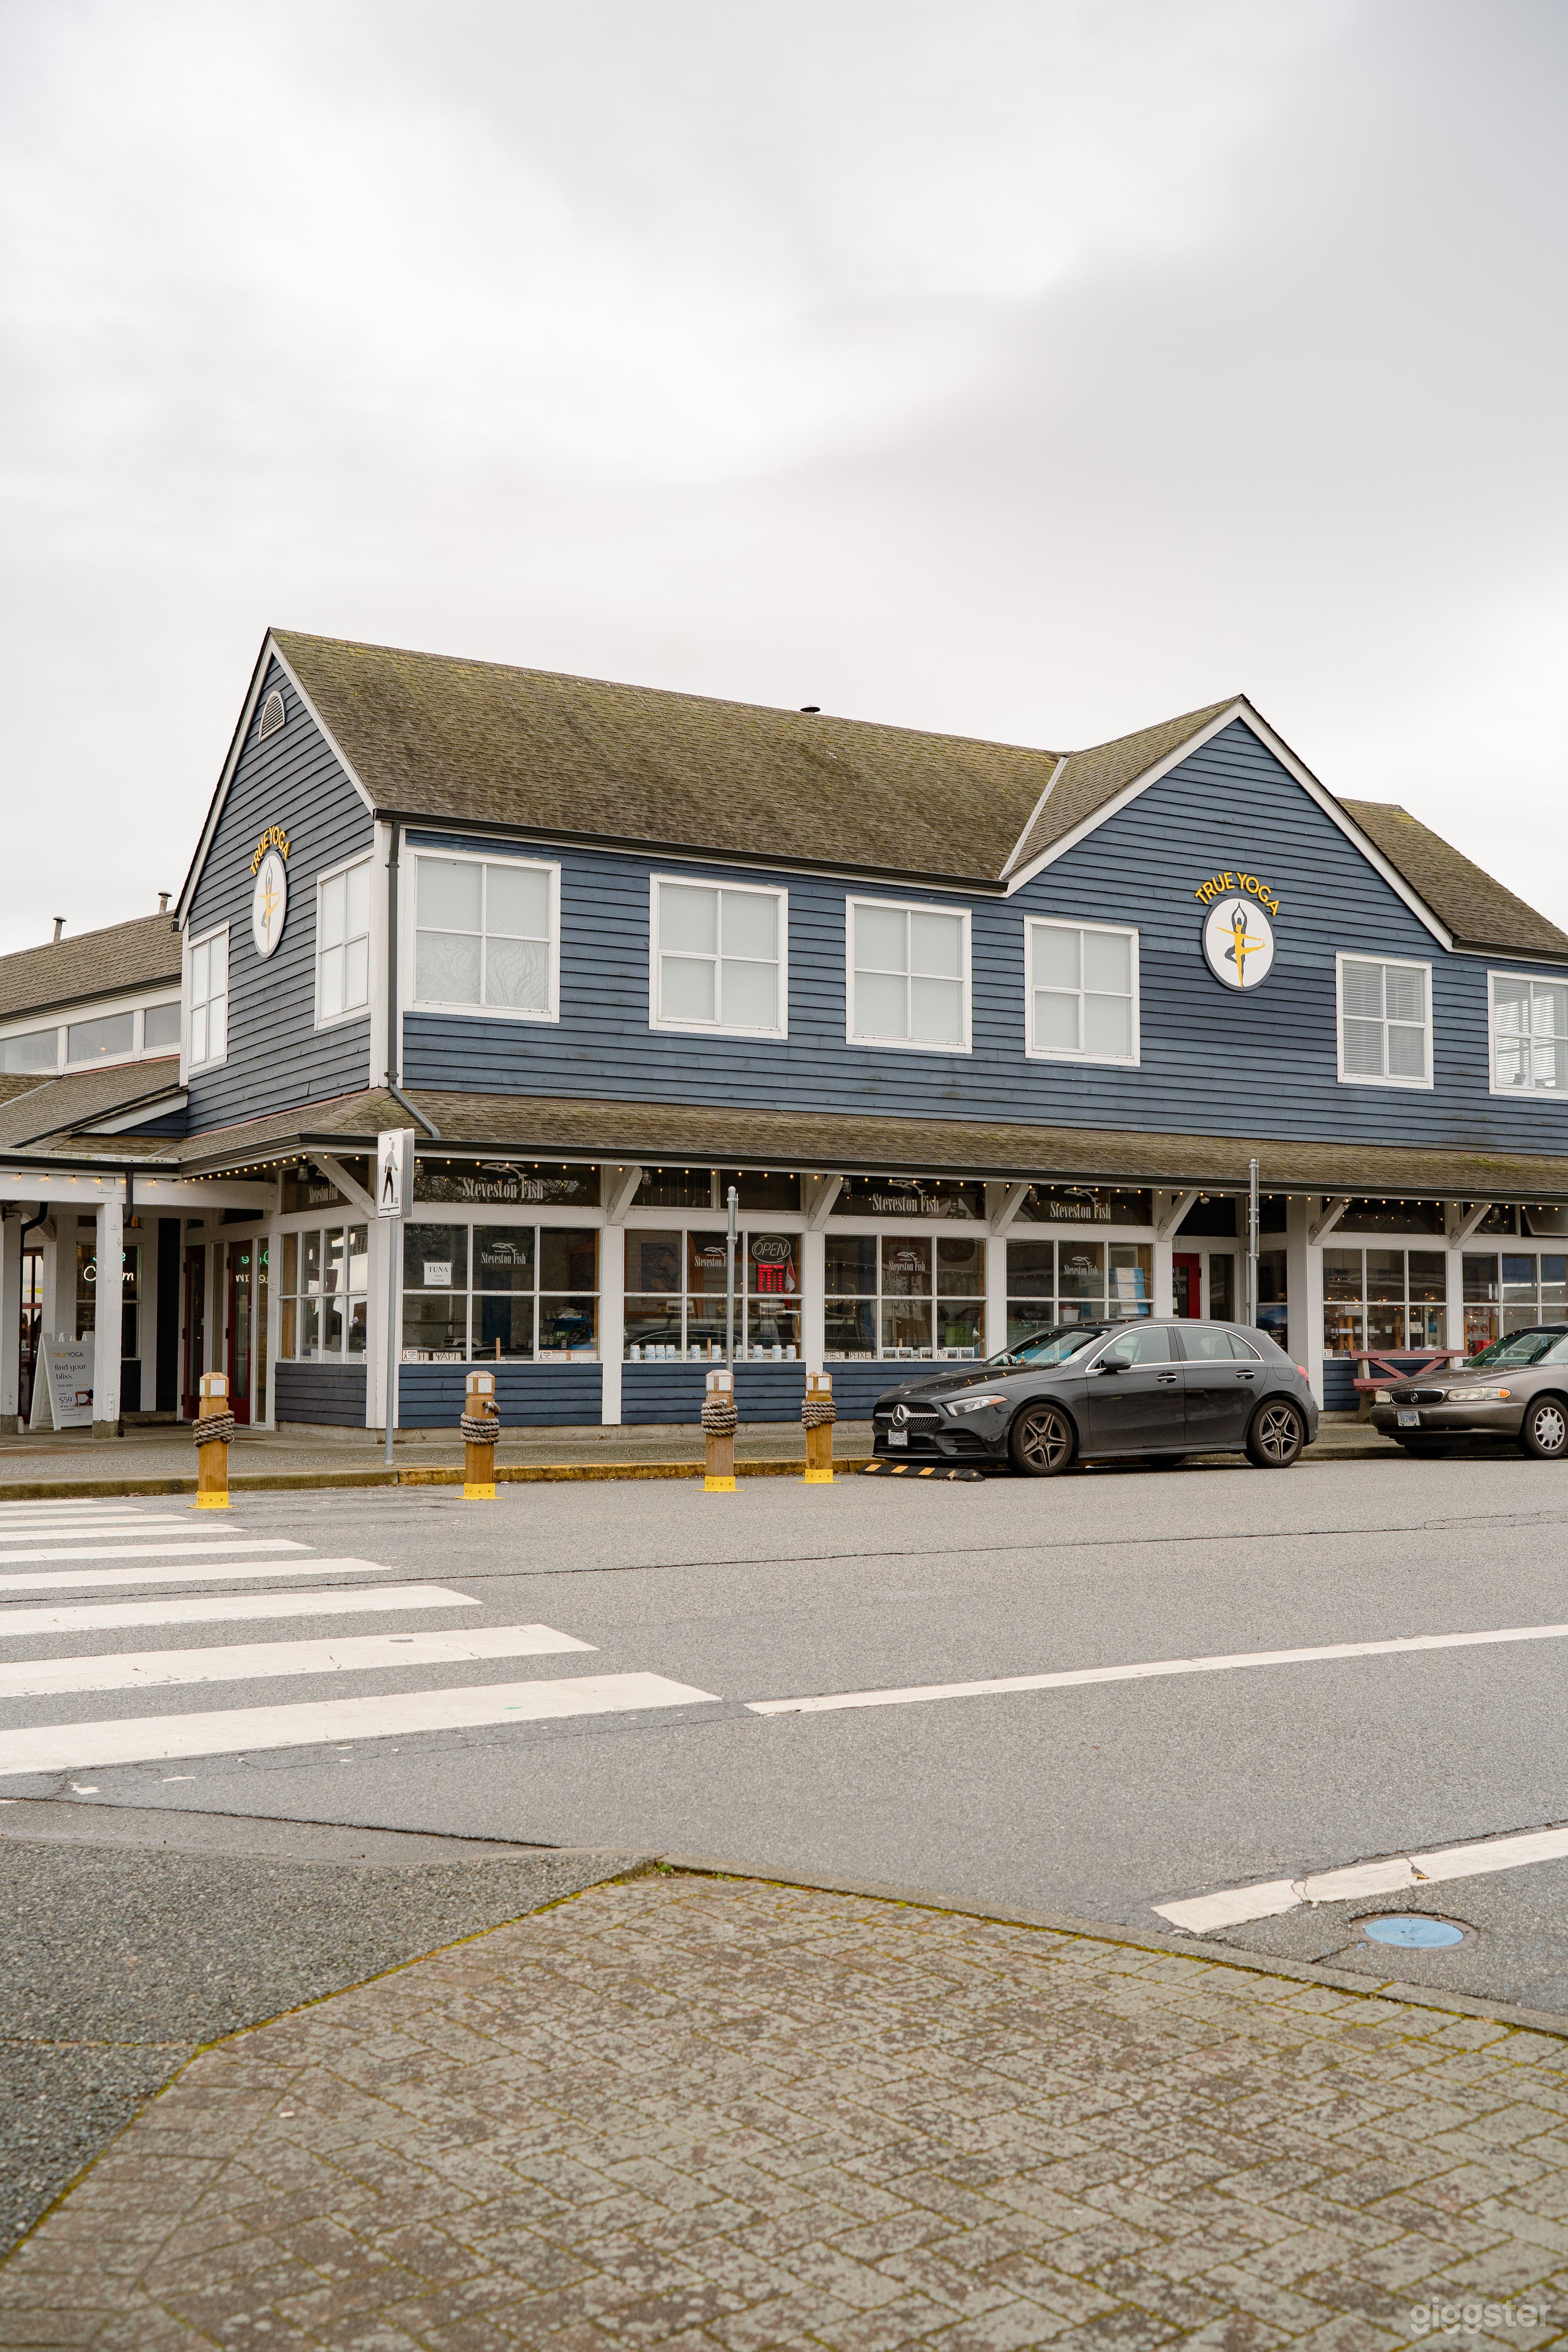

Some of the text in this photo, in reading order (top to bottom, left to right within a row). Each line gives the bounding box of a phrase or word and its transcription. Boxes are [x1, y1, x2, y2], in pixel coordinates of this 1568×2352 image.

[250, 826, 290, 875] TRUE YOGA
[1194, 872, 1279, 916] TRUE YOGA
[309, 1181, 338, 1204] Steveston Fish
[463, 1177, 544, 1199] Steveston Fish
[873, 1193, 939, 1212] Steveston Fish
[1050, 1200, 1111, 1219] Steveston Fish
[754, 1242, 787, 1257] OPEN
[481, 1252, 526, 1265] Steveston Fish
[694, 1255, 722, 1267] Steveston
[889, 1260, 926, 1272] Steveston Fish
[1064, 1264, 1098, 1275] Steveston Fish
[850, 1351, 869, 1359] PEIXE
[70, 1364, 87, 1372] your
[59, 1396, 72, 1404] $59
